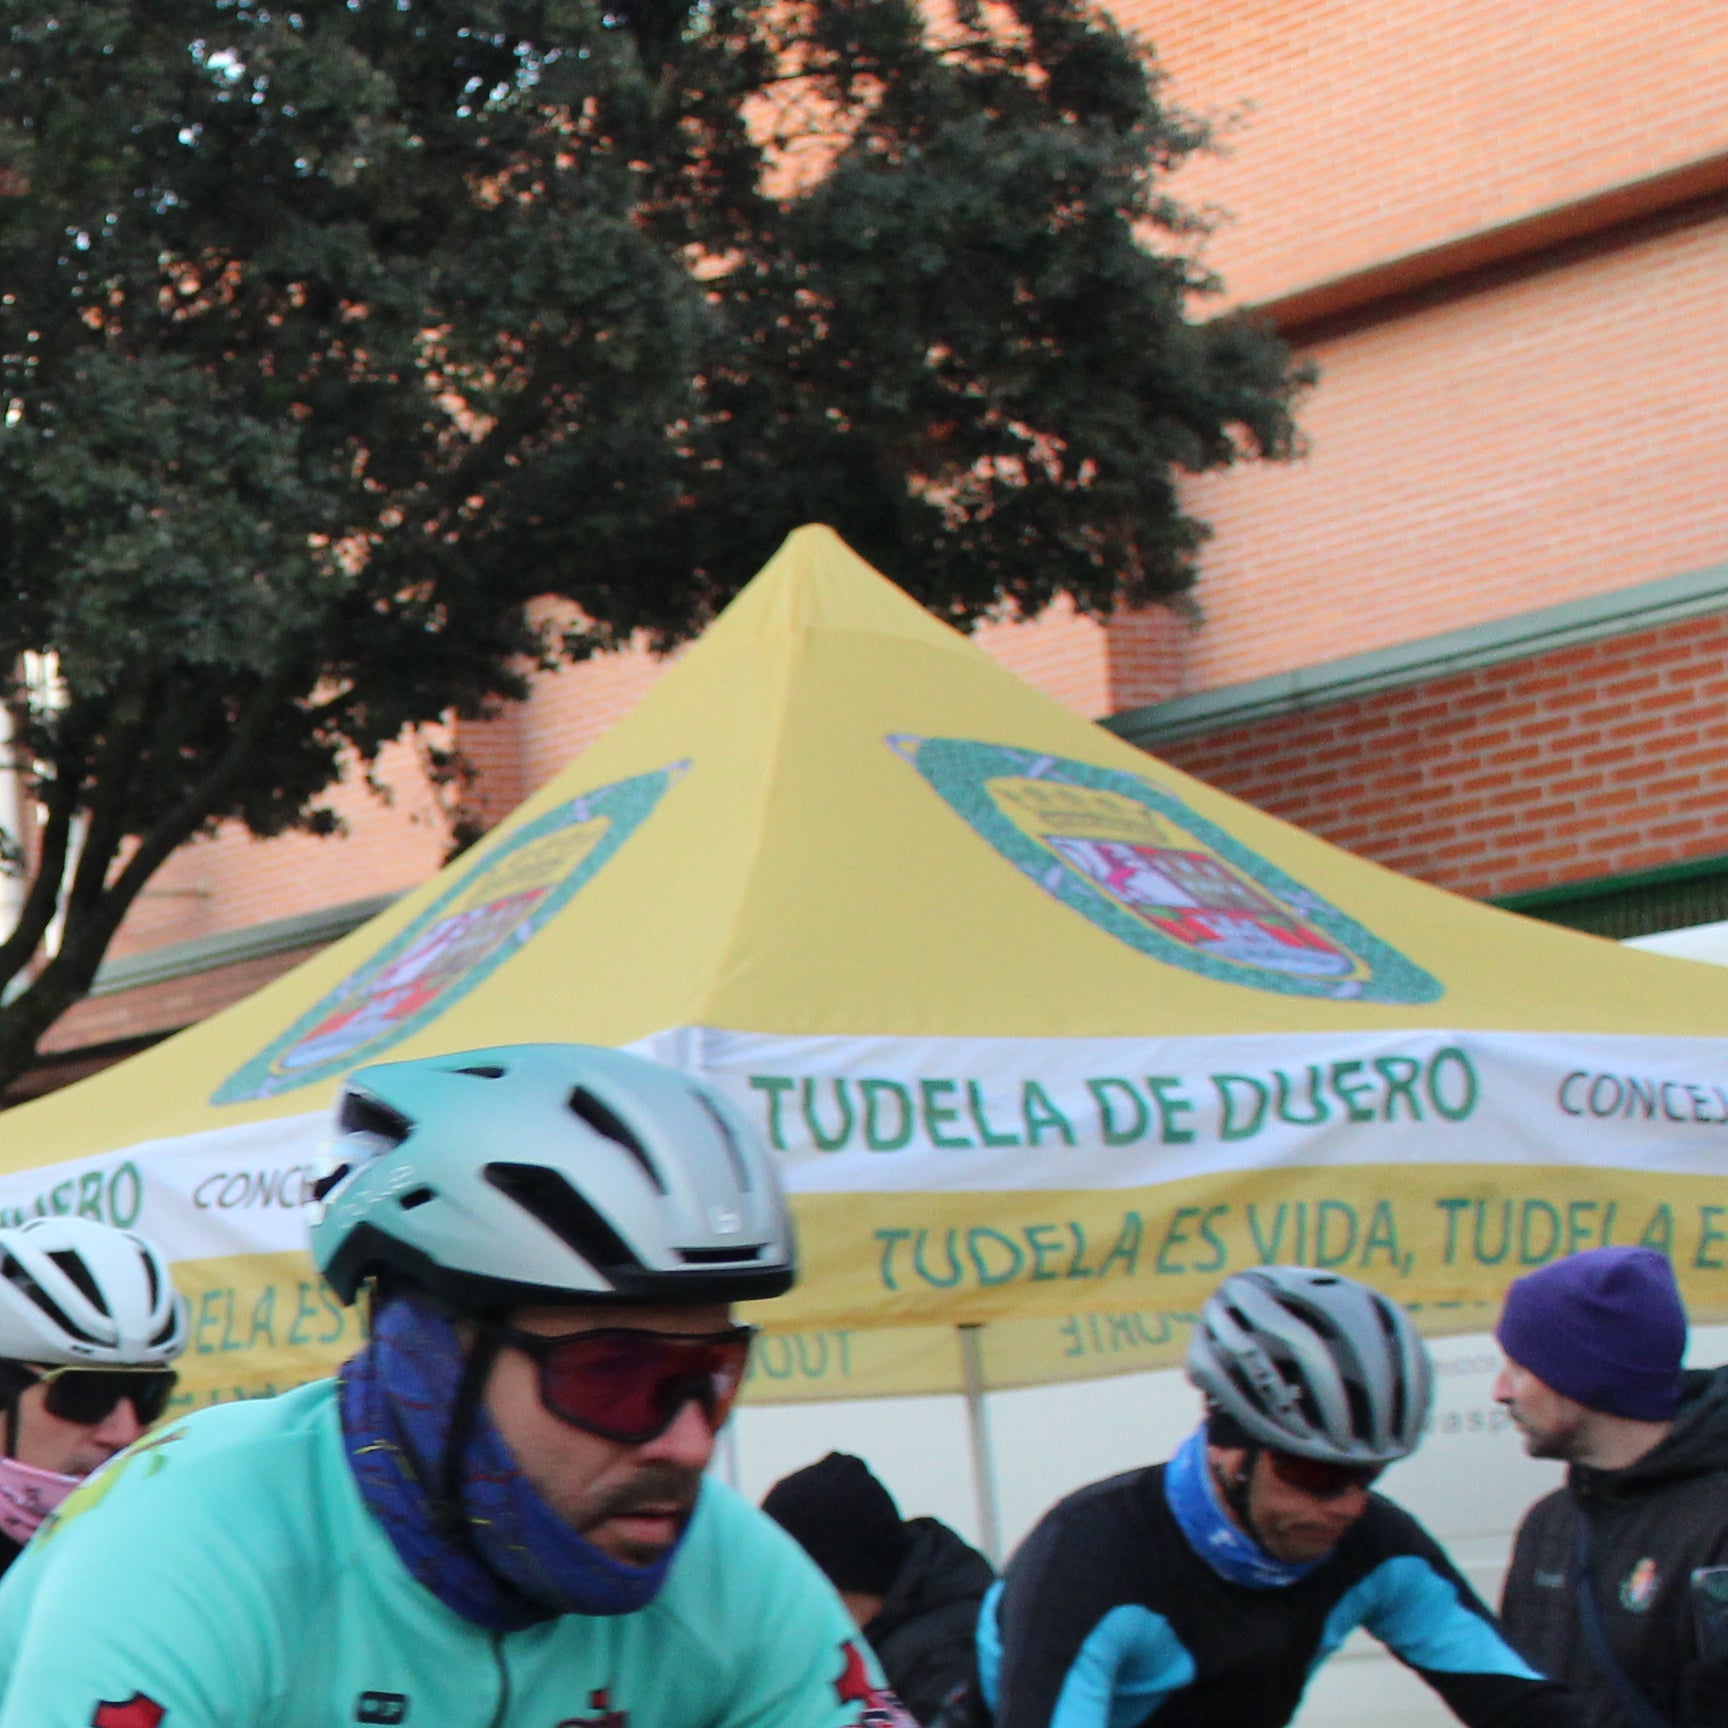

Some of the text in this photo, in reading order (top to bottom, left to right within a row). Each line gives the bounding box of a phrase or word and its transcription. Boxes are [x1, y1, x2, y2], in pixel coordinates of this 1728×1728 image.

[748, 1045, 1480, 1152] TUDELA DE DUERO
[1557, 1070, 1728, 1124] CONCEJ
[194, 1164, 320, 1209] CONC
[874, 1211, 1144, 1291] TUDELA
[1155, 1204, 1232, 1275] ES
[1247, 1199, 1415, 1278] VIDA,
[1436, 1198, 1675, 1267] TUDELA
